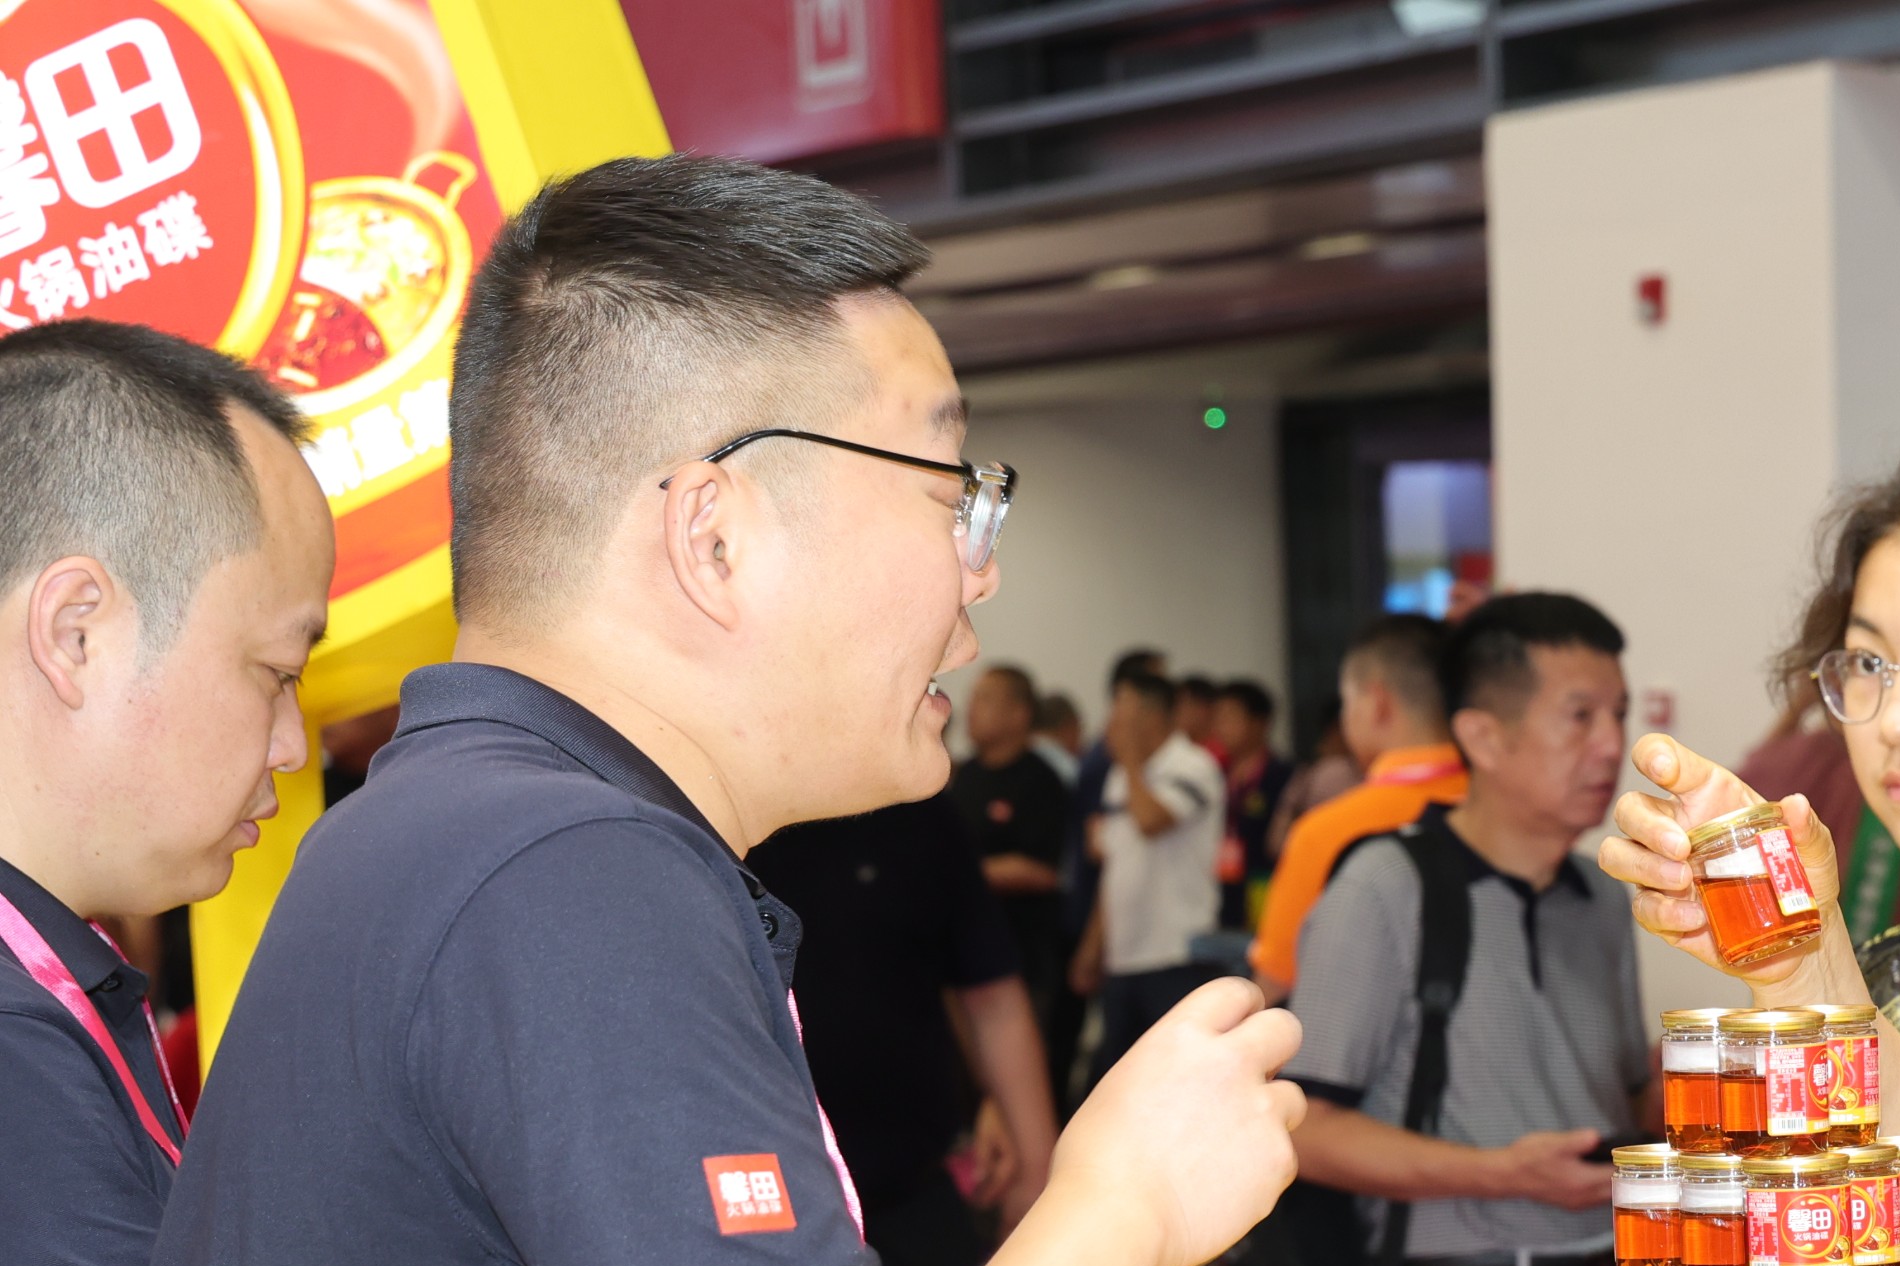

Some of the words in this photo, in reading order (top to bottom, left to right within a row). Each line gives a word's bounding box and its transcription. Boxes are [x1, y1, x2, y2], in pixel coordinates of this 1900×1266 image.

[1813, 1063, 1829, 1087] 馨
[1787, 1208, 1832, 1233] 馨田
[1794, 1232, 1829, 1242] 火锅油碟
